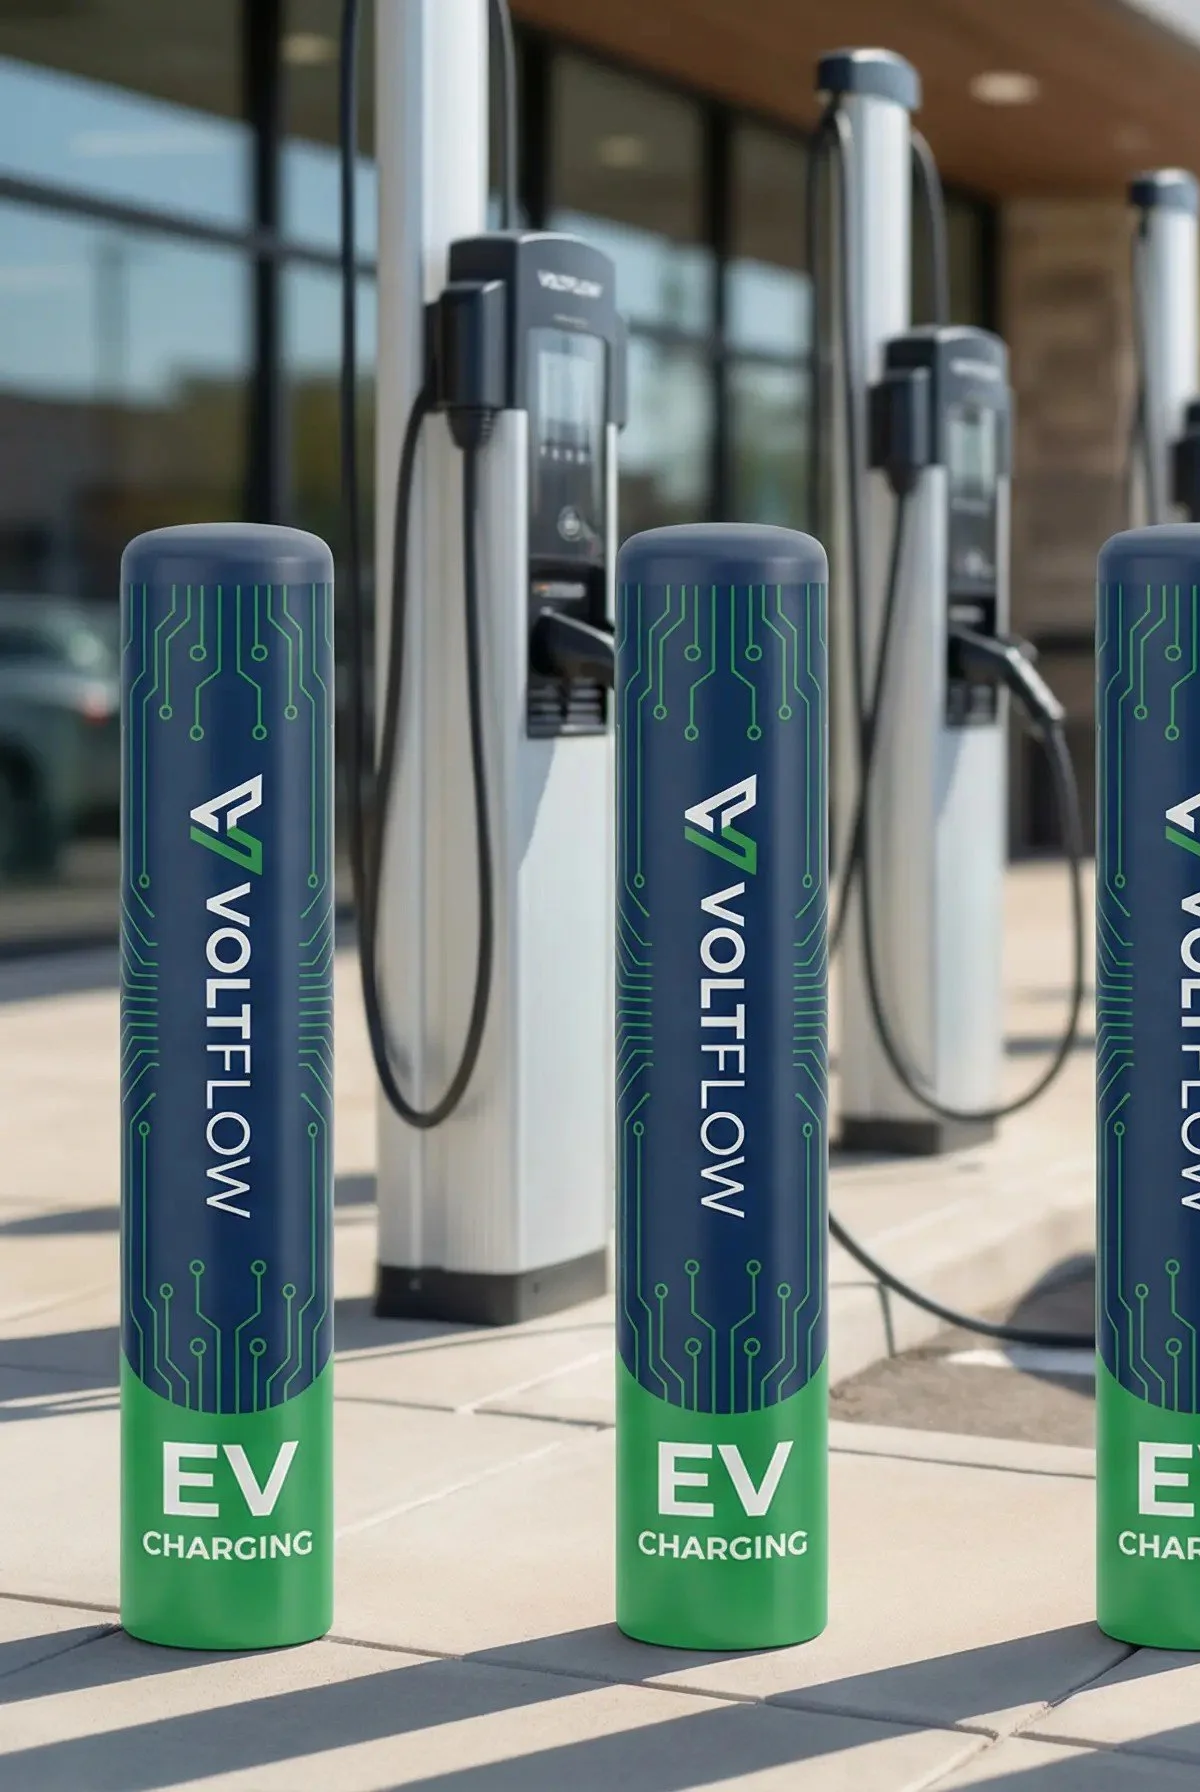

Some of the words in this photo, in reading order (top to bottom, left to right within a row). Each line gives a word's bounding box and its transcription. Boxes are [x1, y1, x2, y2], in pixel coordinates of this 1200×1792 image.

[206, 882, 251, 1218] VOLTFLOW
[701, 882, 745, 1218] VOLTFLOW
[164, 1441, 298, 1517] EV
[659, 1441, 793, 1517] EV
[143, 1531, 313, 1560] CHARGING
[638, 1531, 807, 1560] CHARGING
